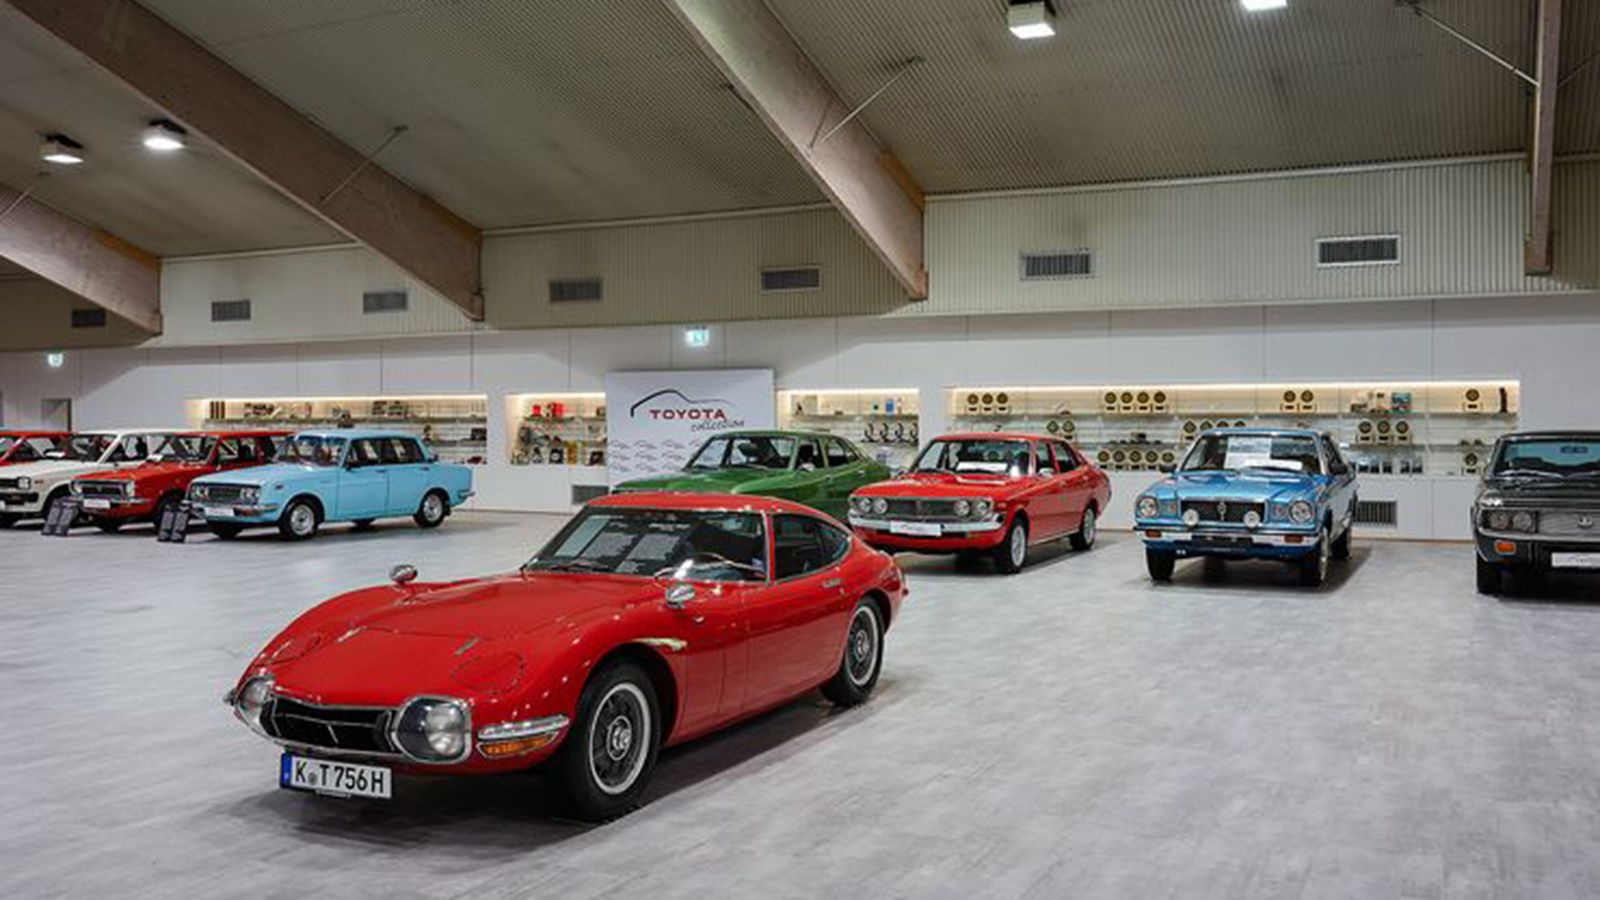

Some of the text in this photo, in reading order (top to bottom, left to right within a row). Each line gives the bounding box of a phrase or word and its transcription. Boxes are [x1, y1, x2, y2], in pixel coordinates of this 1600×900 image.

[649, 409, 726, 420] TOYOTA
[691, 419, 745, 432] collection
[295, 761, 308, 783] K
